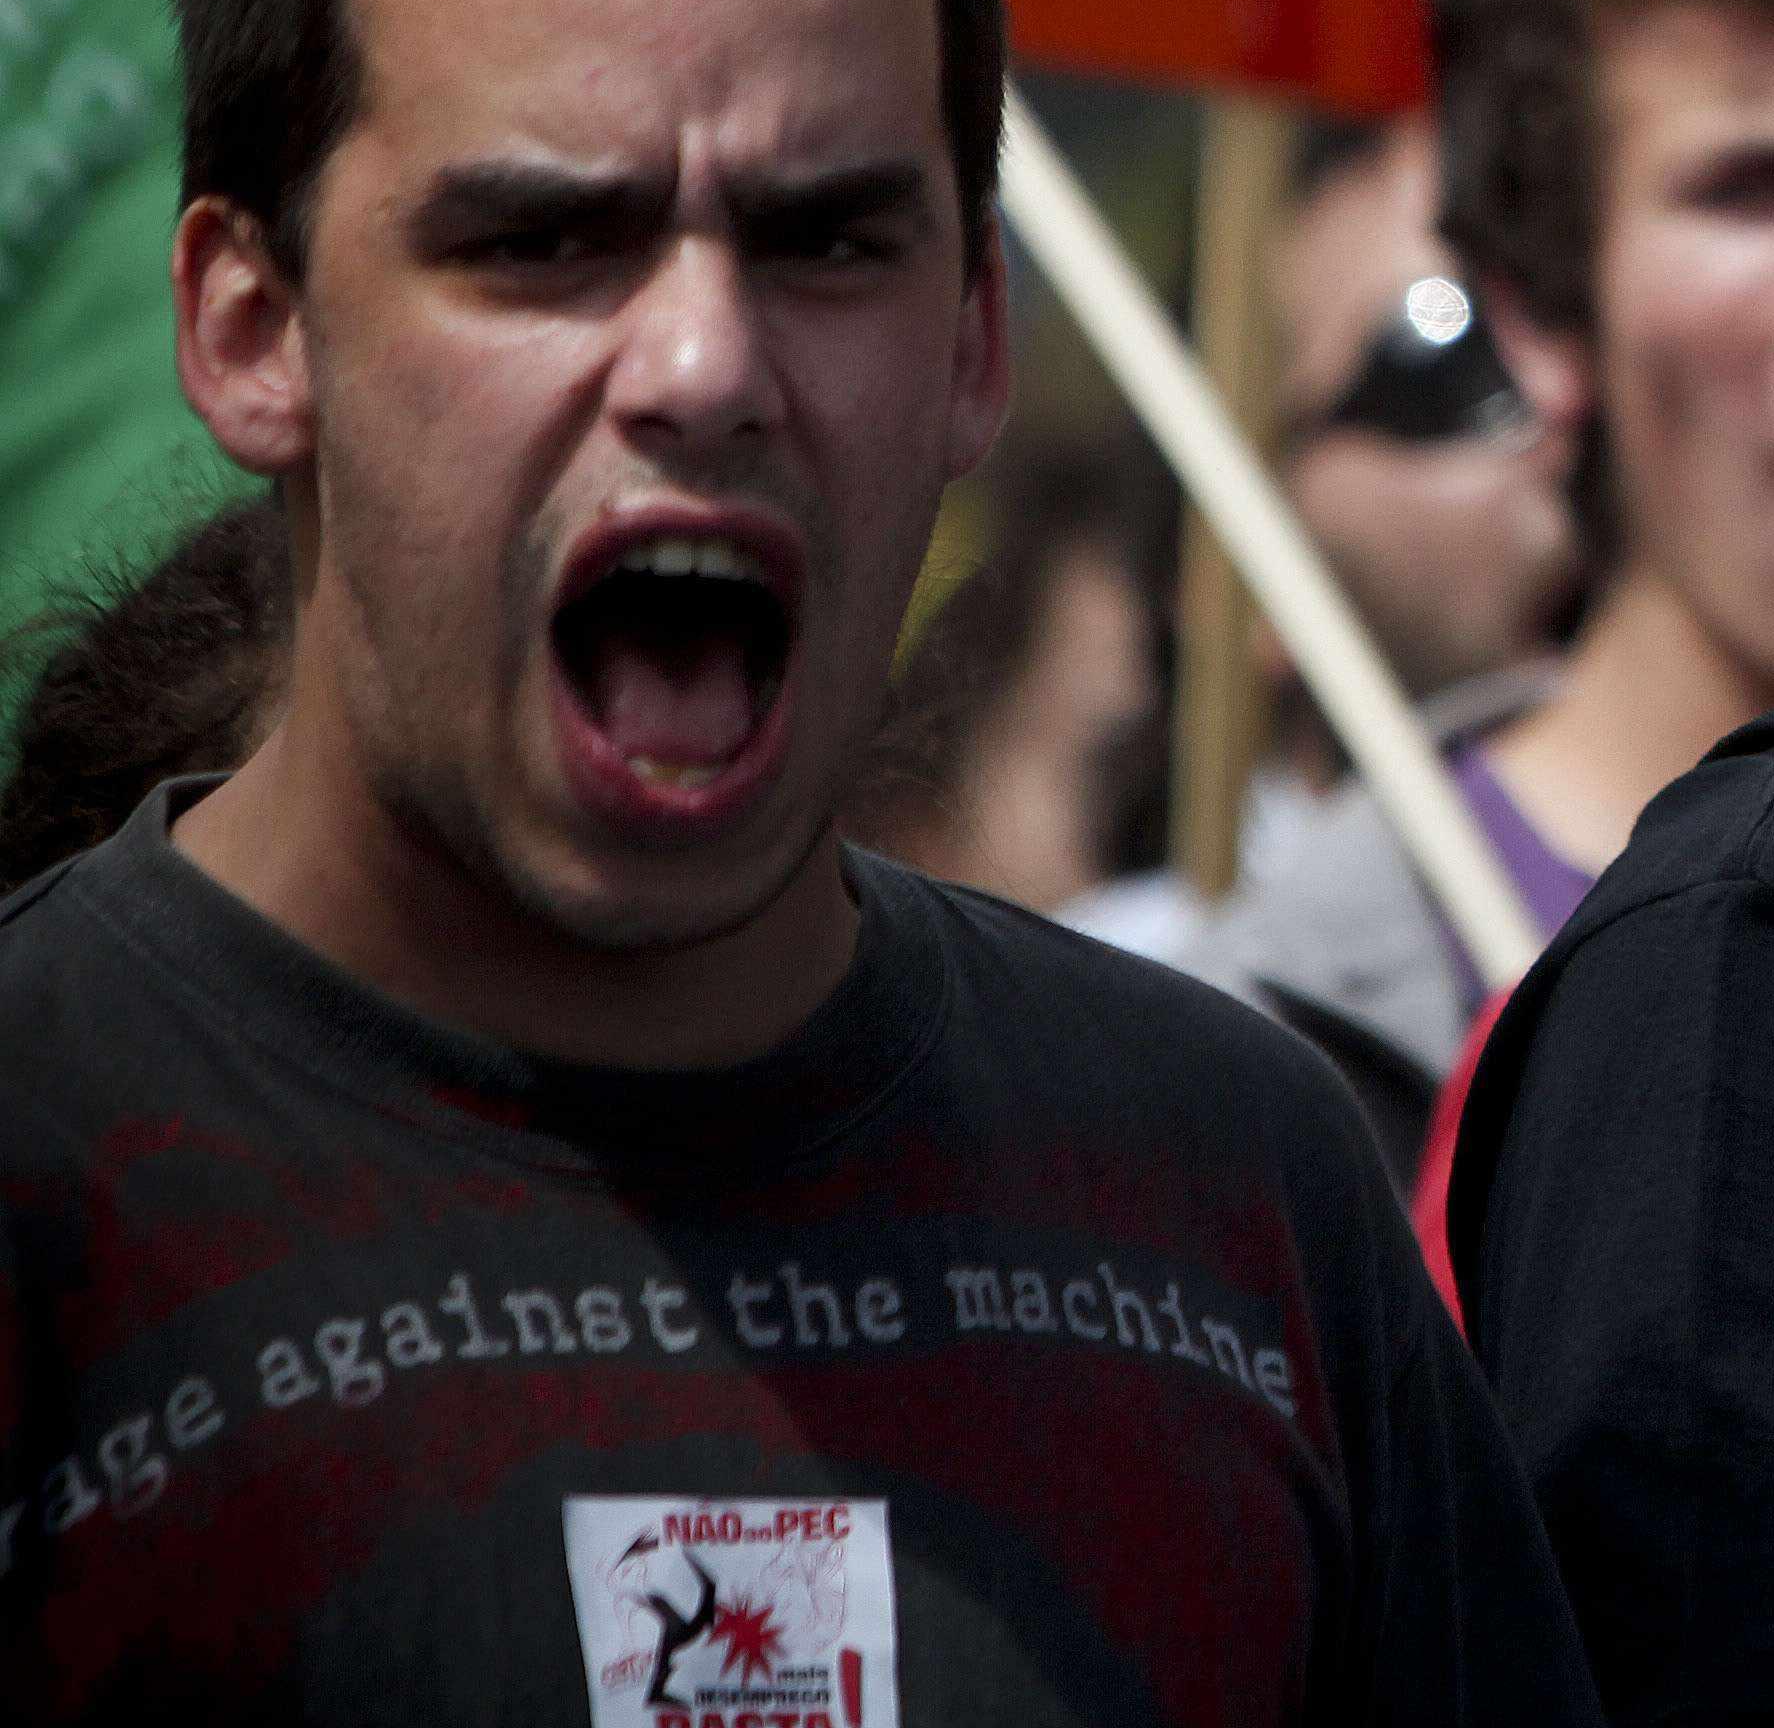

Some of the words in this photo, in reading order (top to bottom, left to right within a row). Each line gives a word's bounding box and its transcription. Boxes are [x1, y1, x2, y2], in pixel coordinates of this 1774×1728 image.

[256, 1274, 700, 1409] against
[728, 1264, 904, 1348] the
[951, 1264, 1298, 1417] machine
[661, 1498, 742, 1546] NÃO
[773, 1504, 852, 1544] PEC
